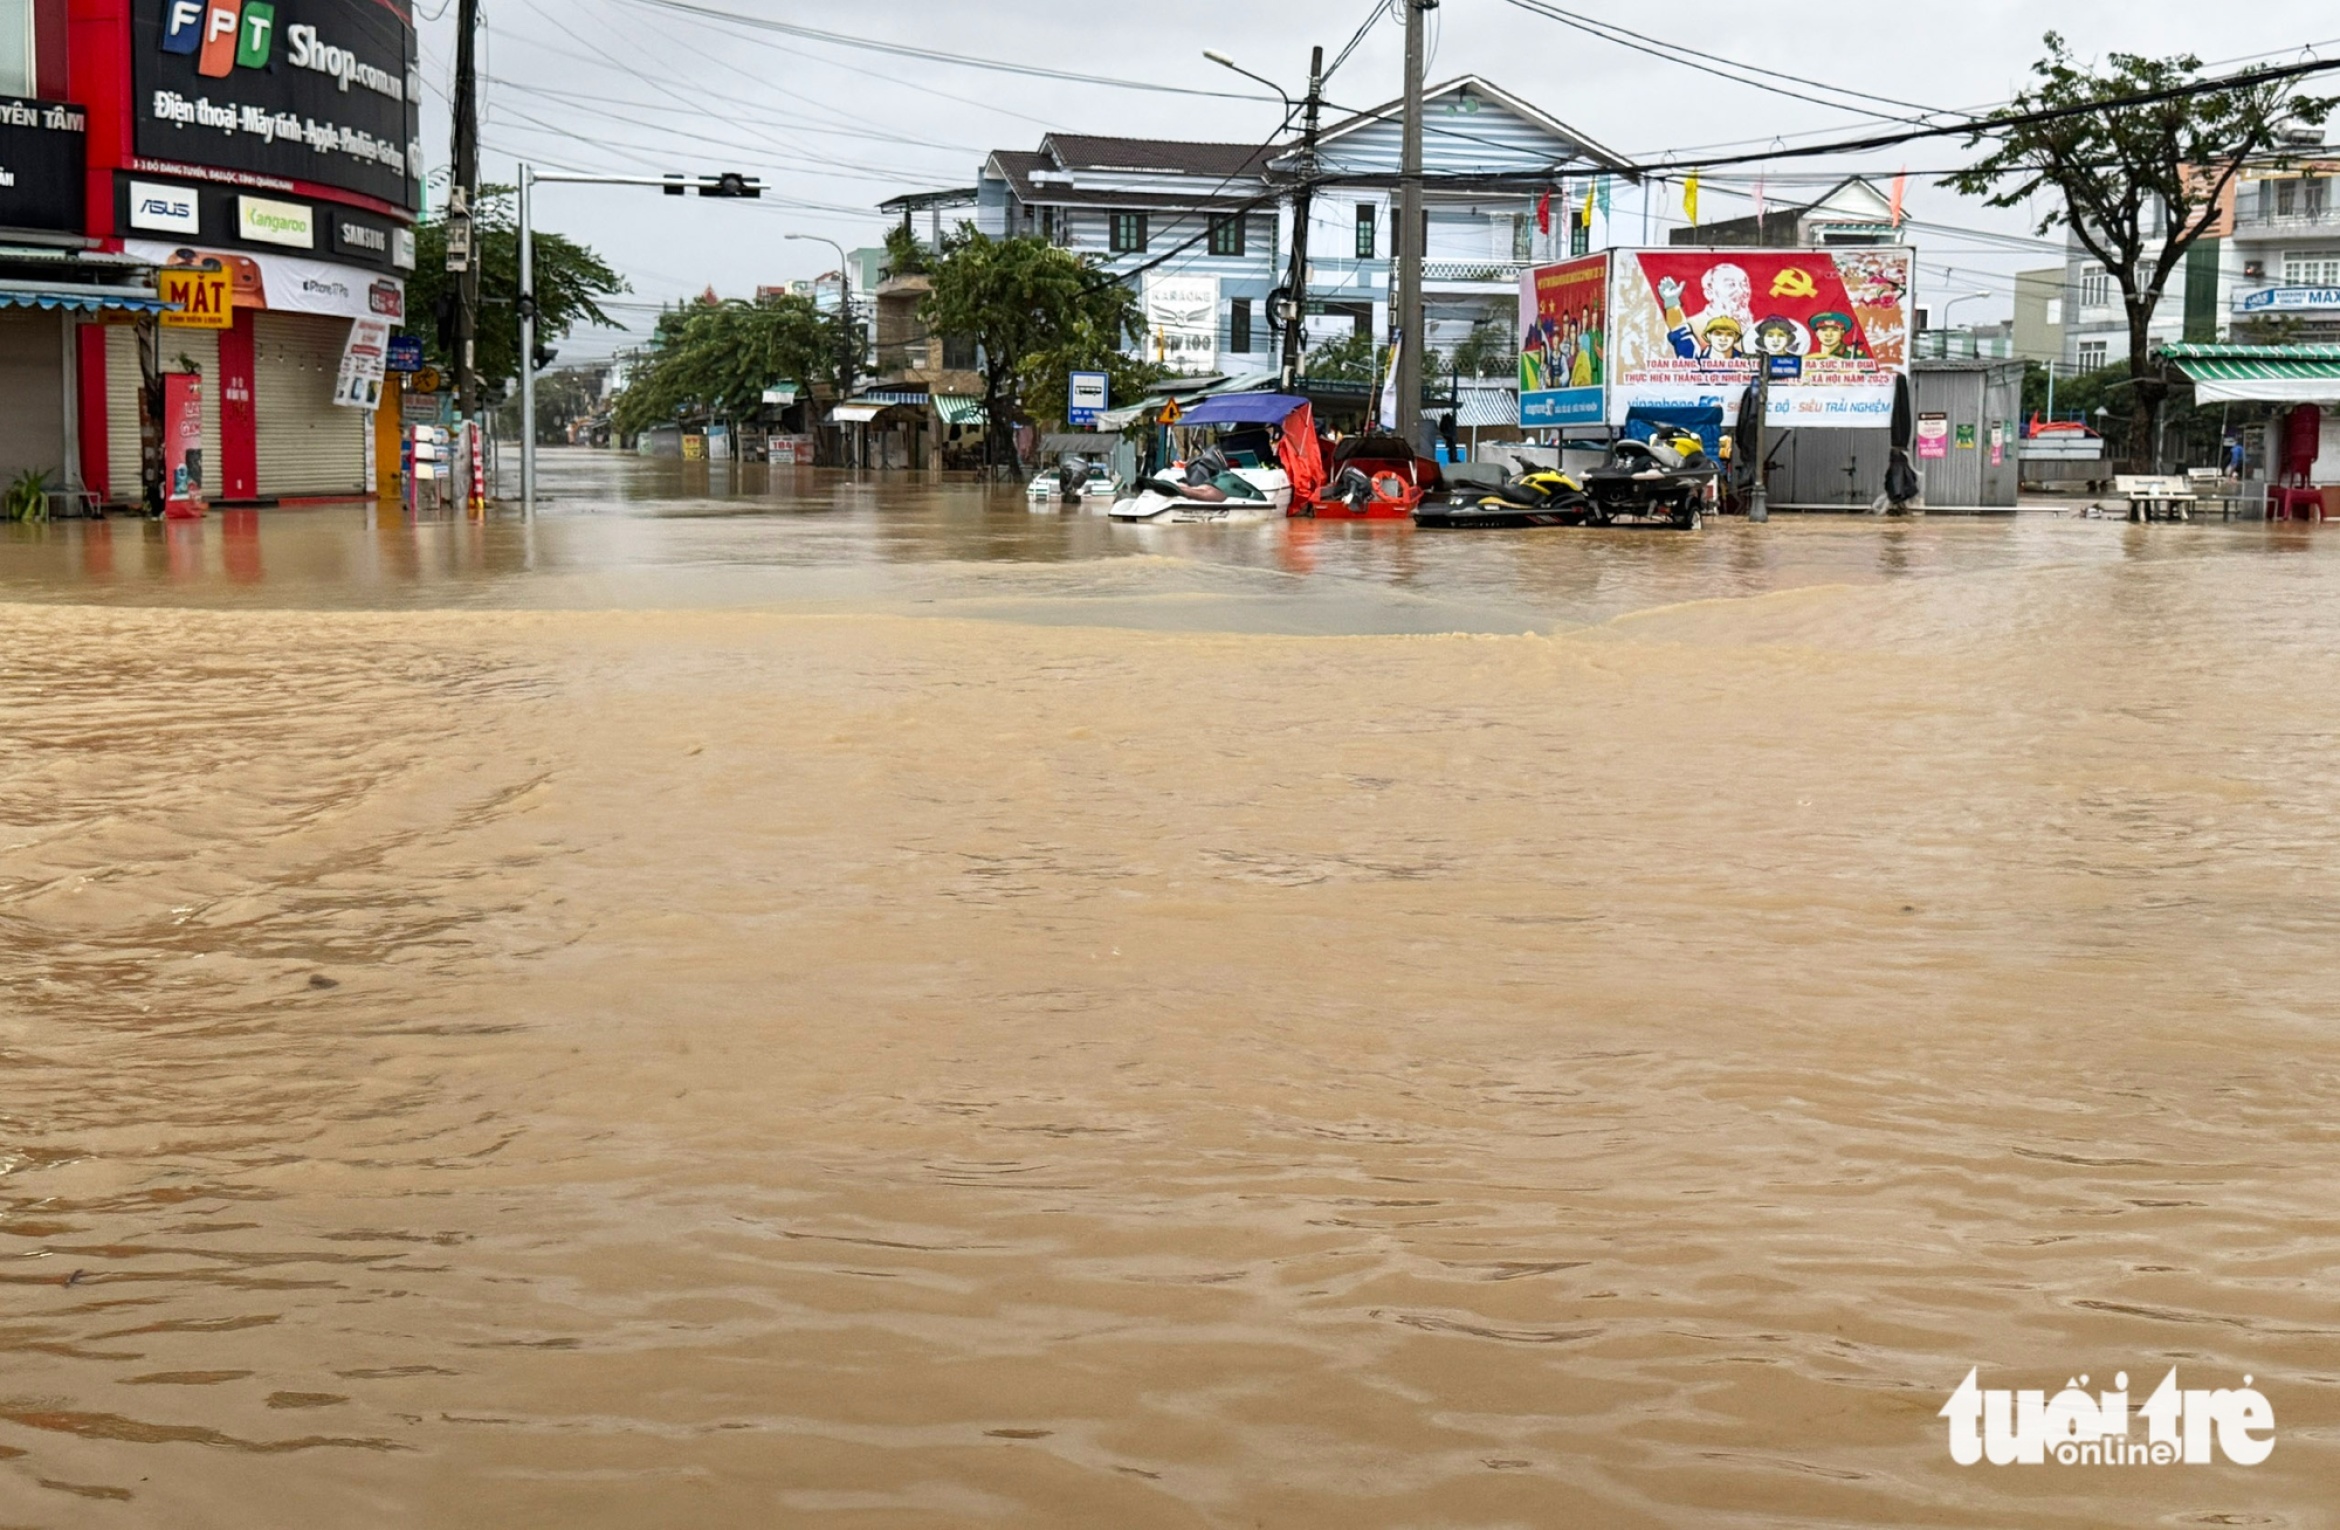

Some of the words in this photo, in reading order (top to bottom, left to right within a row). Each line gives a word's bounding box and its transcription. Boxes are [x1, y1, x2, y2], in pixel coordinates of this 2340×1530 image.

[170, 1, 270, 51] FPT
[41, 105, 85, 132] TÂM
[153, 91, 195, 129] Điện
[195, 97, 237, 136] thoại
[242, 105, 275, 143] Máy
[275, 112, 302, 141] tính
[140, 199, 190, 218] ASUS
[246, 206, 306, 233] Kangaroo
[341, 223, 385, 250] SAMSUNG
[1184, 334, 1212, 351] 100
[1805, 360, 1816, 369] RA
[1841, 359, 1854, 369] THI
[1775, 399, 1790, 414] ĐỘ
[1798, 398, 1823, 413] SIÊU
[1825, 396, 1847, 413] TRẢI
[1850, 398, 1891, 415] NGHIỆM
